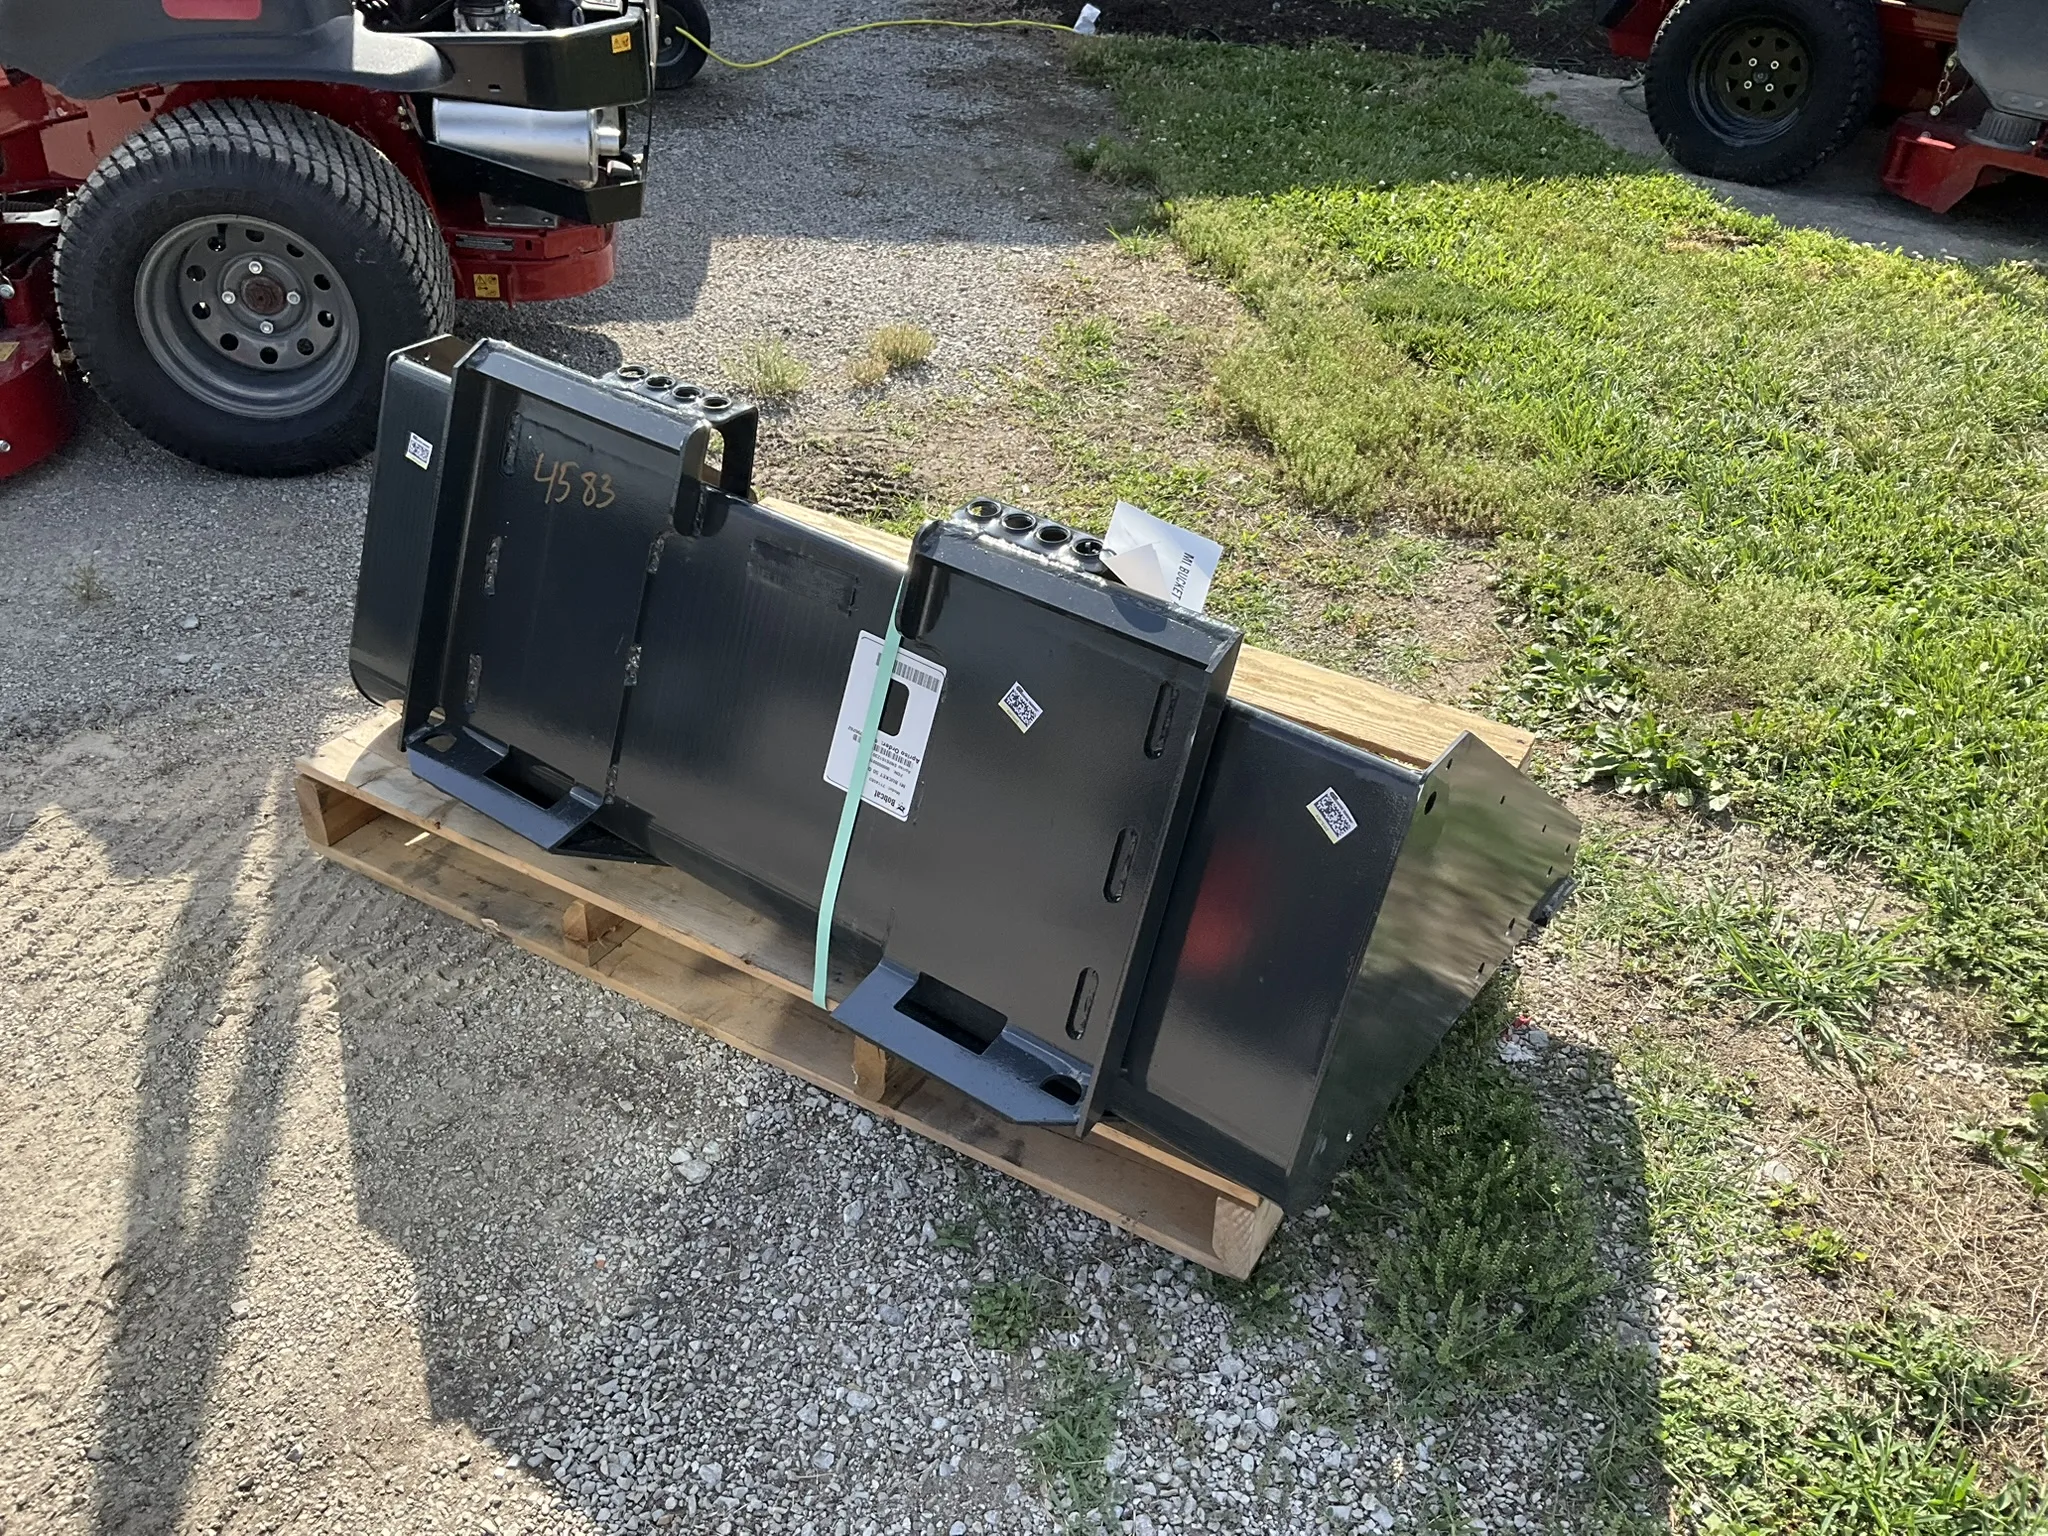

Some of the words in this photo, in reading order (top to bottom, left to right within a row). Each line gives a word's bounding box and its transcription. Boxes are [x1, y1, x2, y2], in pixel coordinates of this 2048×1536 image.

[534, 452, 616, 508] 4583
[1181, 552, 1195, 567] MI
[1171, 565, 1190, 601] BUCKET
[873, 789, 896, 807] Bobcat
